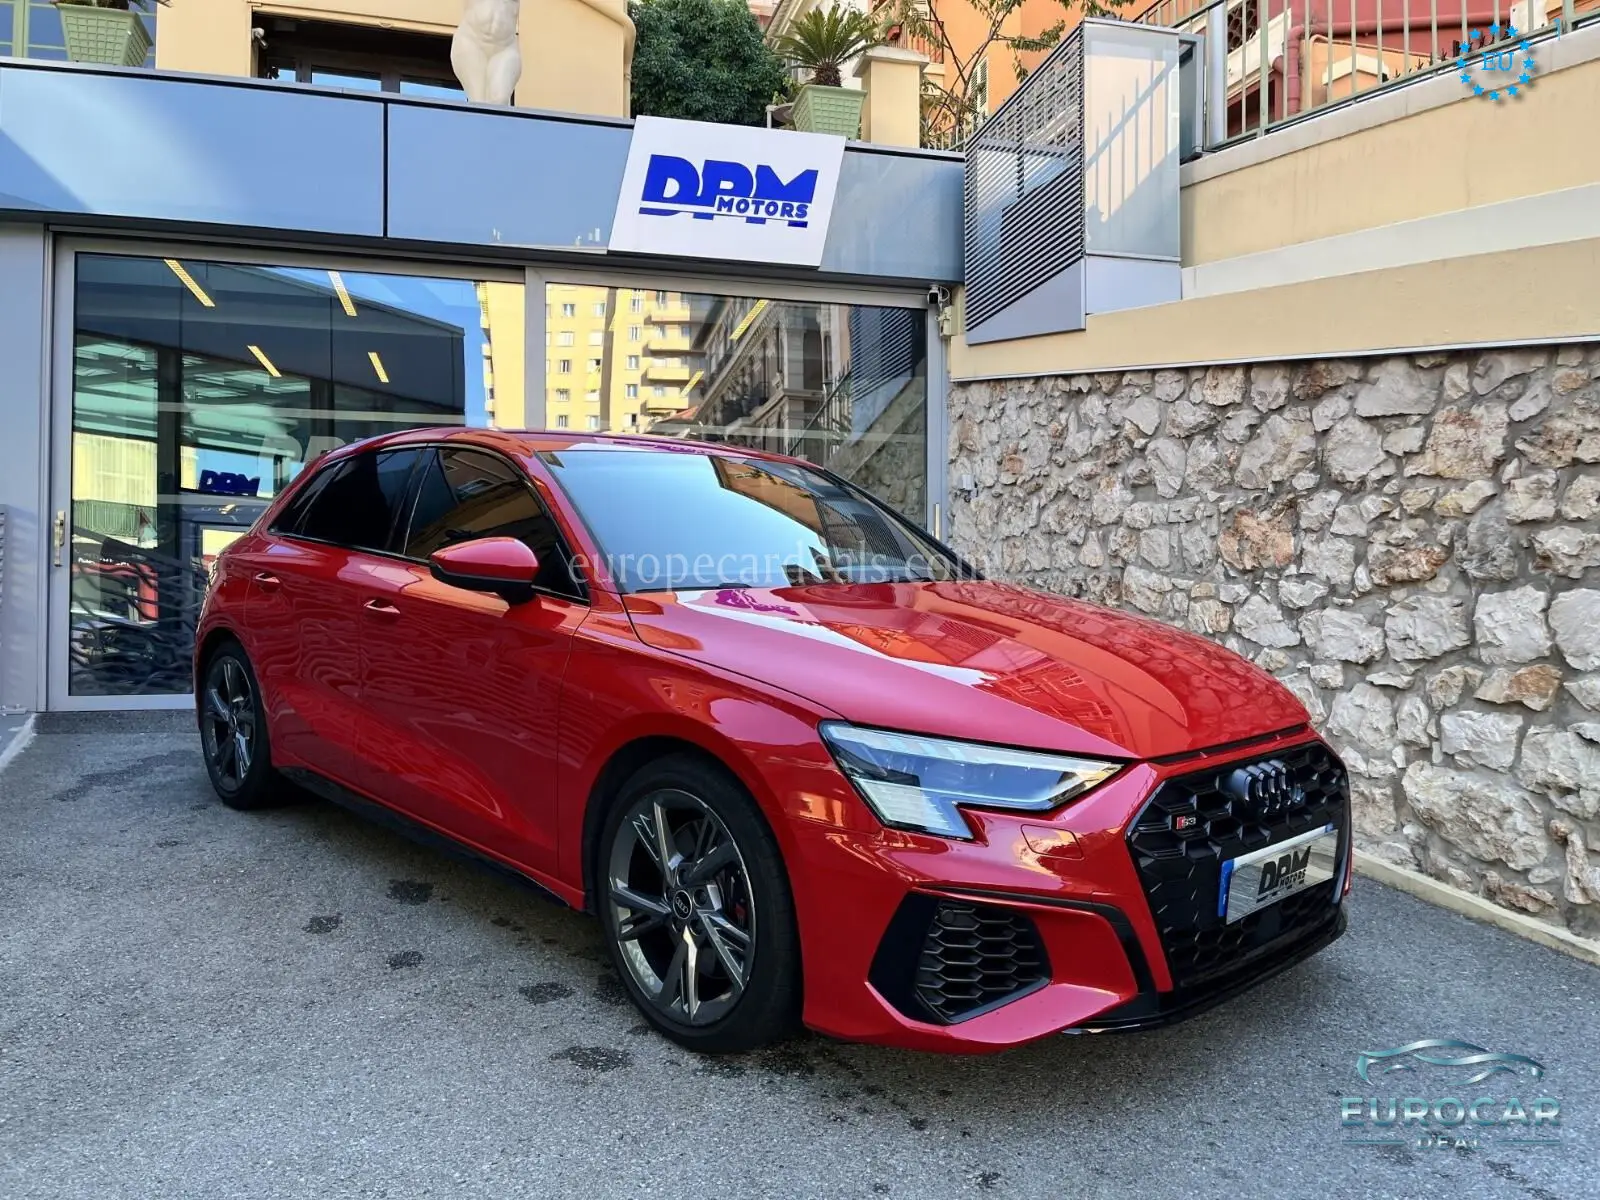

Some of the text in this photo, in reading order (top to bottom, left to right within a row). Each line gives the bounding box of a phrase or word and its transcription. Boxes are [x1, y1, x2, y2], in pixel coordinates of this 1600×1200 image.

[639, 154, 818, 228] DPM
[717, 196, 808, 219] MOTORS
[1256, 845, 1312, 903] DPM
